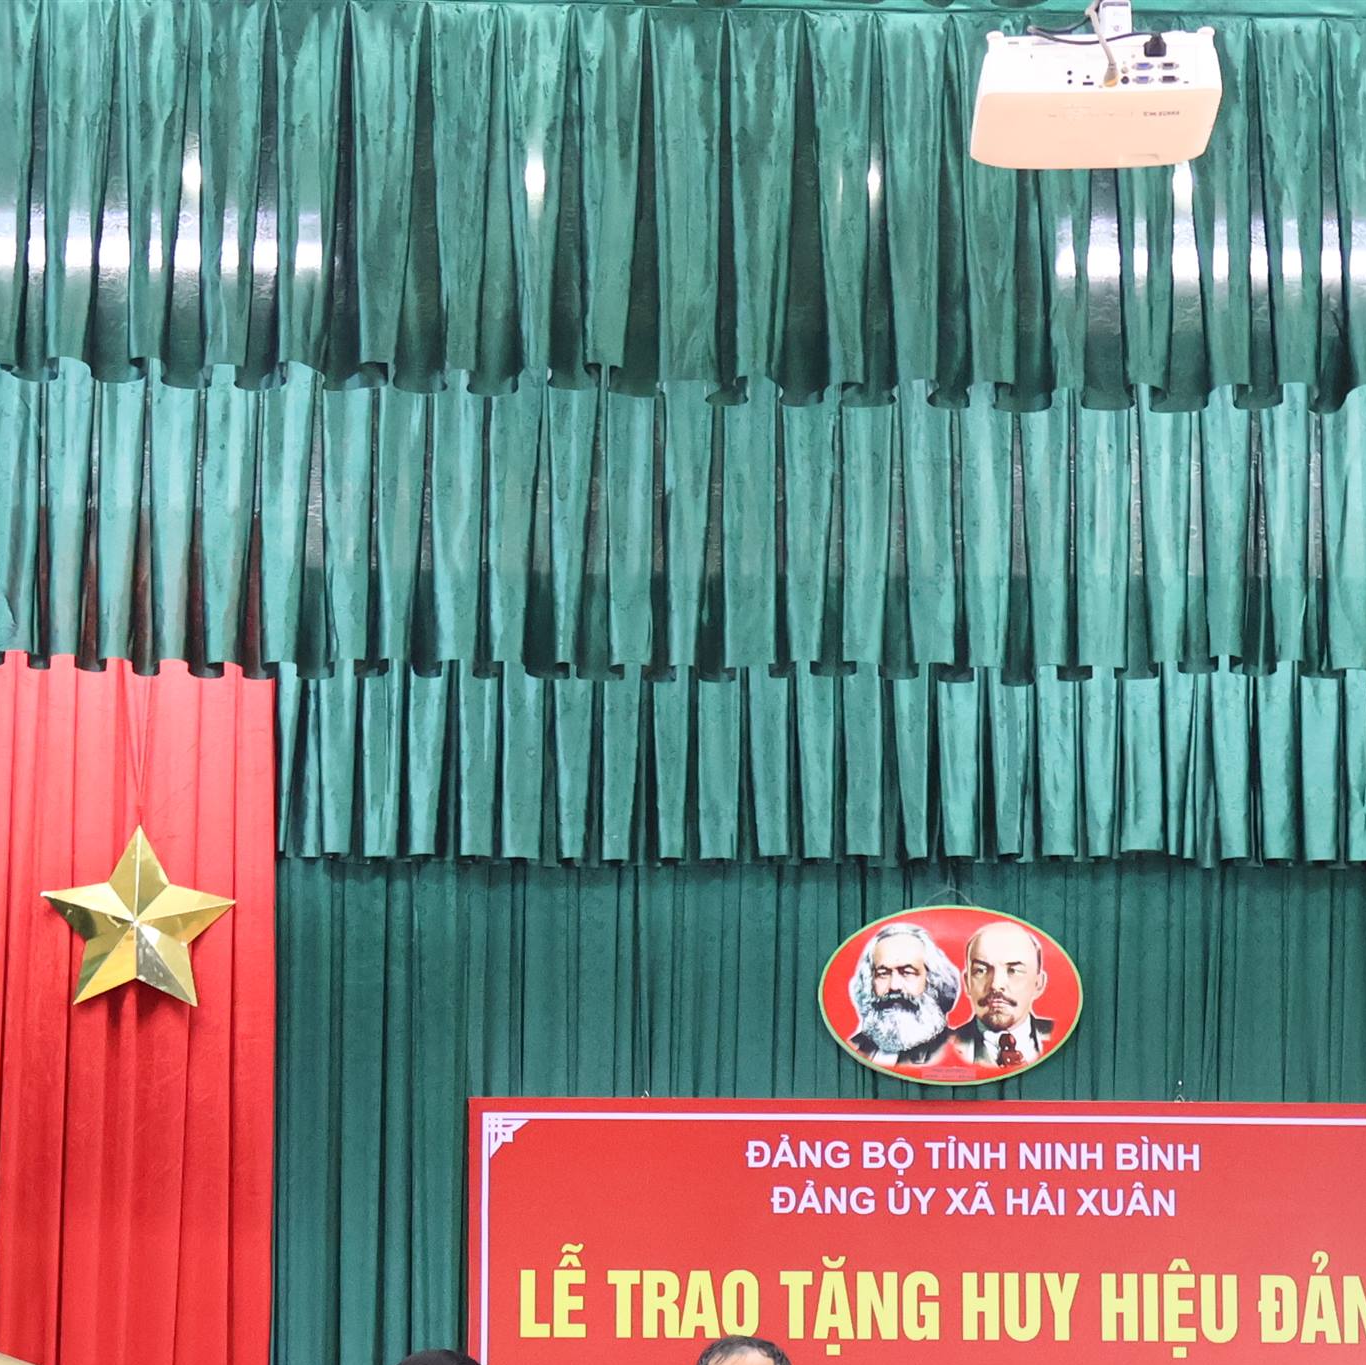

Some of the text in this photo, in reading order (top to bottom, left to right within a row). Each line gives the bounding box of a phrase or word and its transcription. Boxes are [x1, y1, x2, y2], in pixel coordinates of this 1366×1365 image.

[745, 1134, 1201, 1176] ĐẢNG BỘ TỈNH NINH BÌNH
[770, 1180, 1176, 1217] ĐẢNG ỦY XÃ HẢI XUÂN
[519, 1242, 587, 1339] LỄ
[606, 1268, 760, 1339] TRAO
[779, 1255, 941, 1356] TẶNG
[961, 1271, 1081, 1342] HUY
[1100, 1257, 1239, 1359] HIỆU
